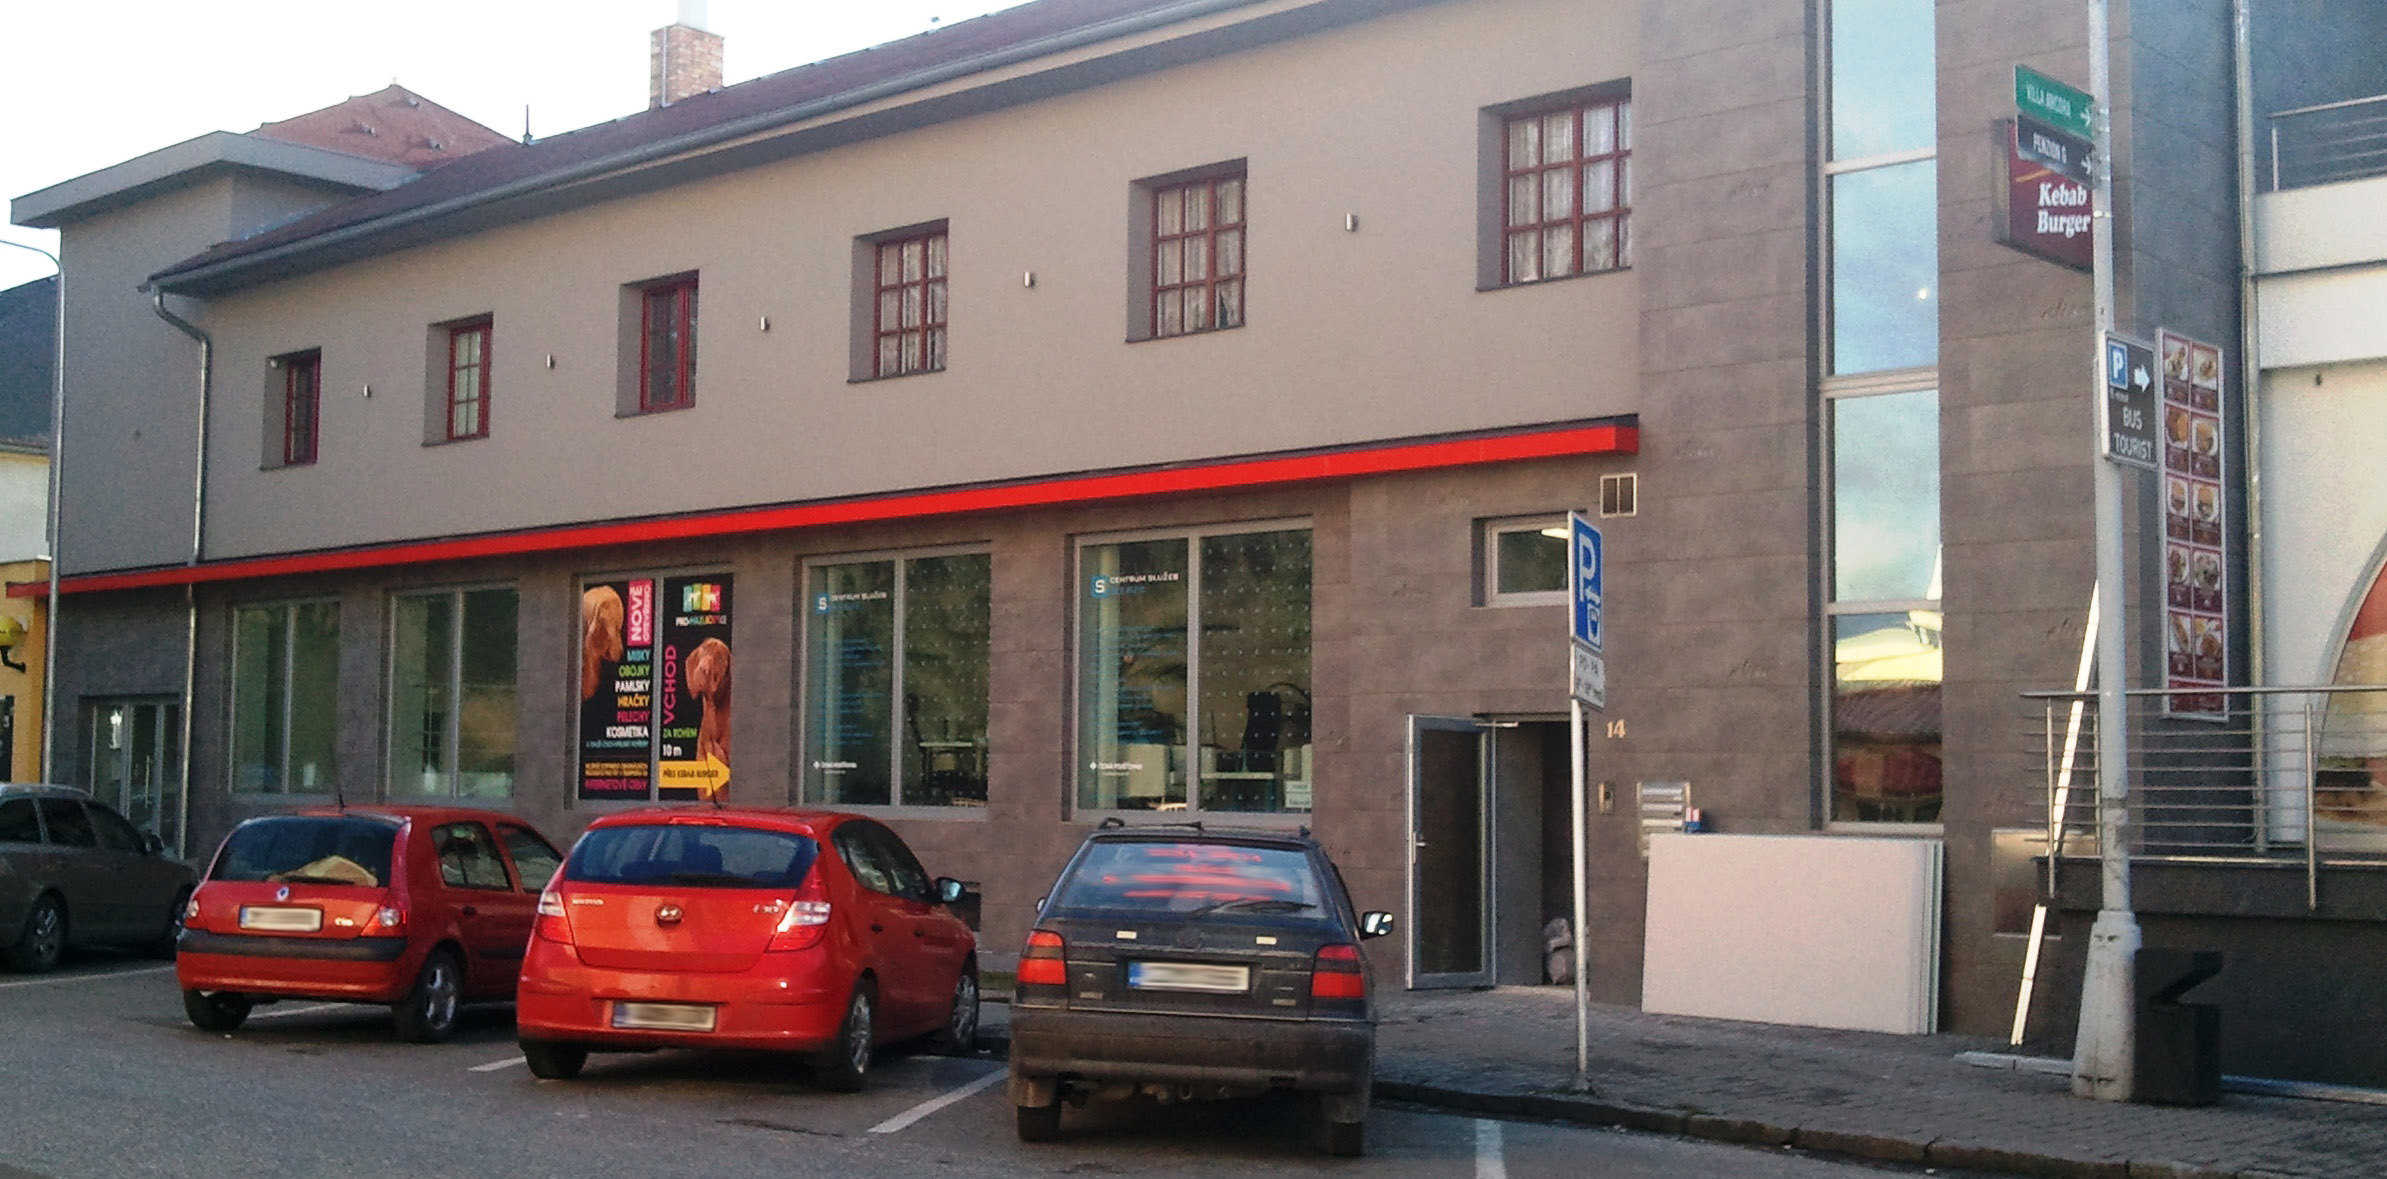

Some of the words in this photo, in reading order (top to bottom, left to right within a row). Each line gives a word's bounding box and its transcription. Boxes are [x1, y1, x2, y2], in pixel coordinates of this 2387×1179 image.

[2038, 182, 2087, 207] Kebab
[2037, 209, 2091, 239] Burger
[2112, 348, 2124, 379] P
[2122, 405, 2142, 431] BUS
[2113, 432, 2152, 461] TOURIST
[1578, 532, 1596, 602] P
[1095, 579, 1106, 594] S
[1109, 574, 1147, 584] CENTRUM
[818, 596, 828, 610] S
[619, 664, 650, 677] OBOJKY
[615, 680, 650, 693] PAMLSKY
[663, 644, 677, 725] VCHOD
[618, 693, 650, 707] HRAČKY
[606, 726, 649, 739] KOSMETIKA
[663, 728, 672, 739] ZA
[1607, 718, 1626, 739] 14
[662, 743, 673, 757] 10
[673, 745, 683, 757] m
